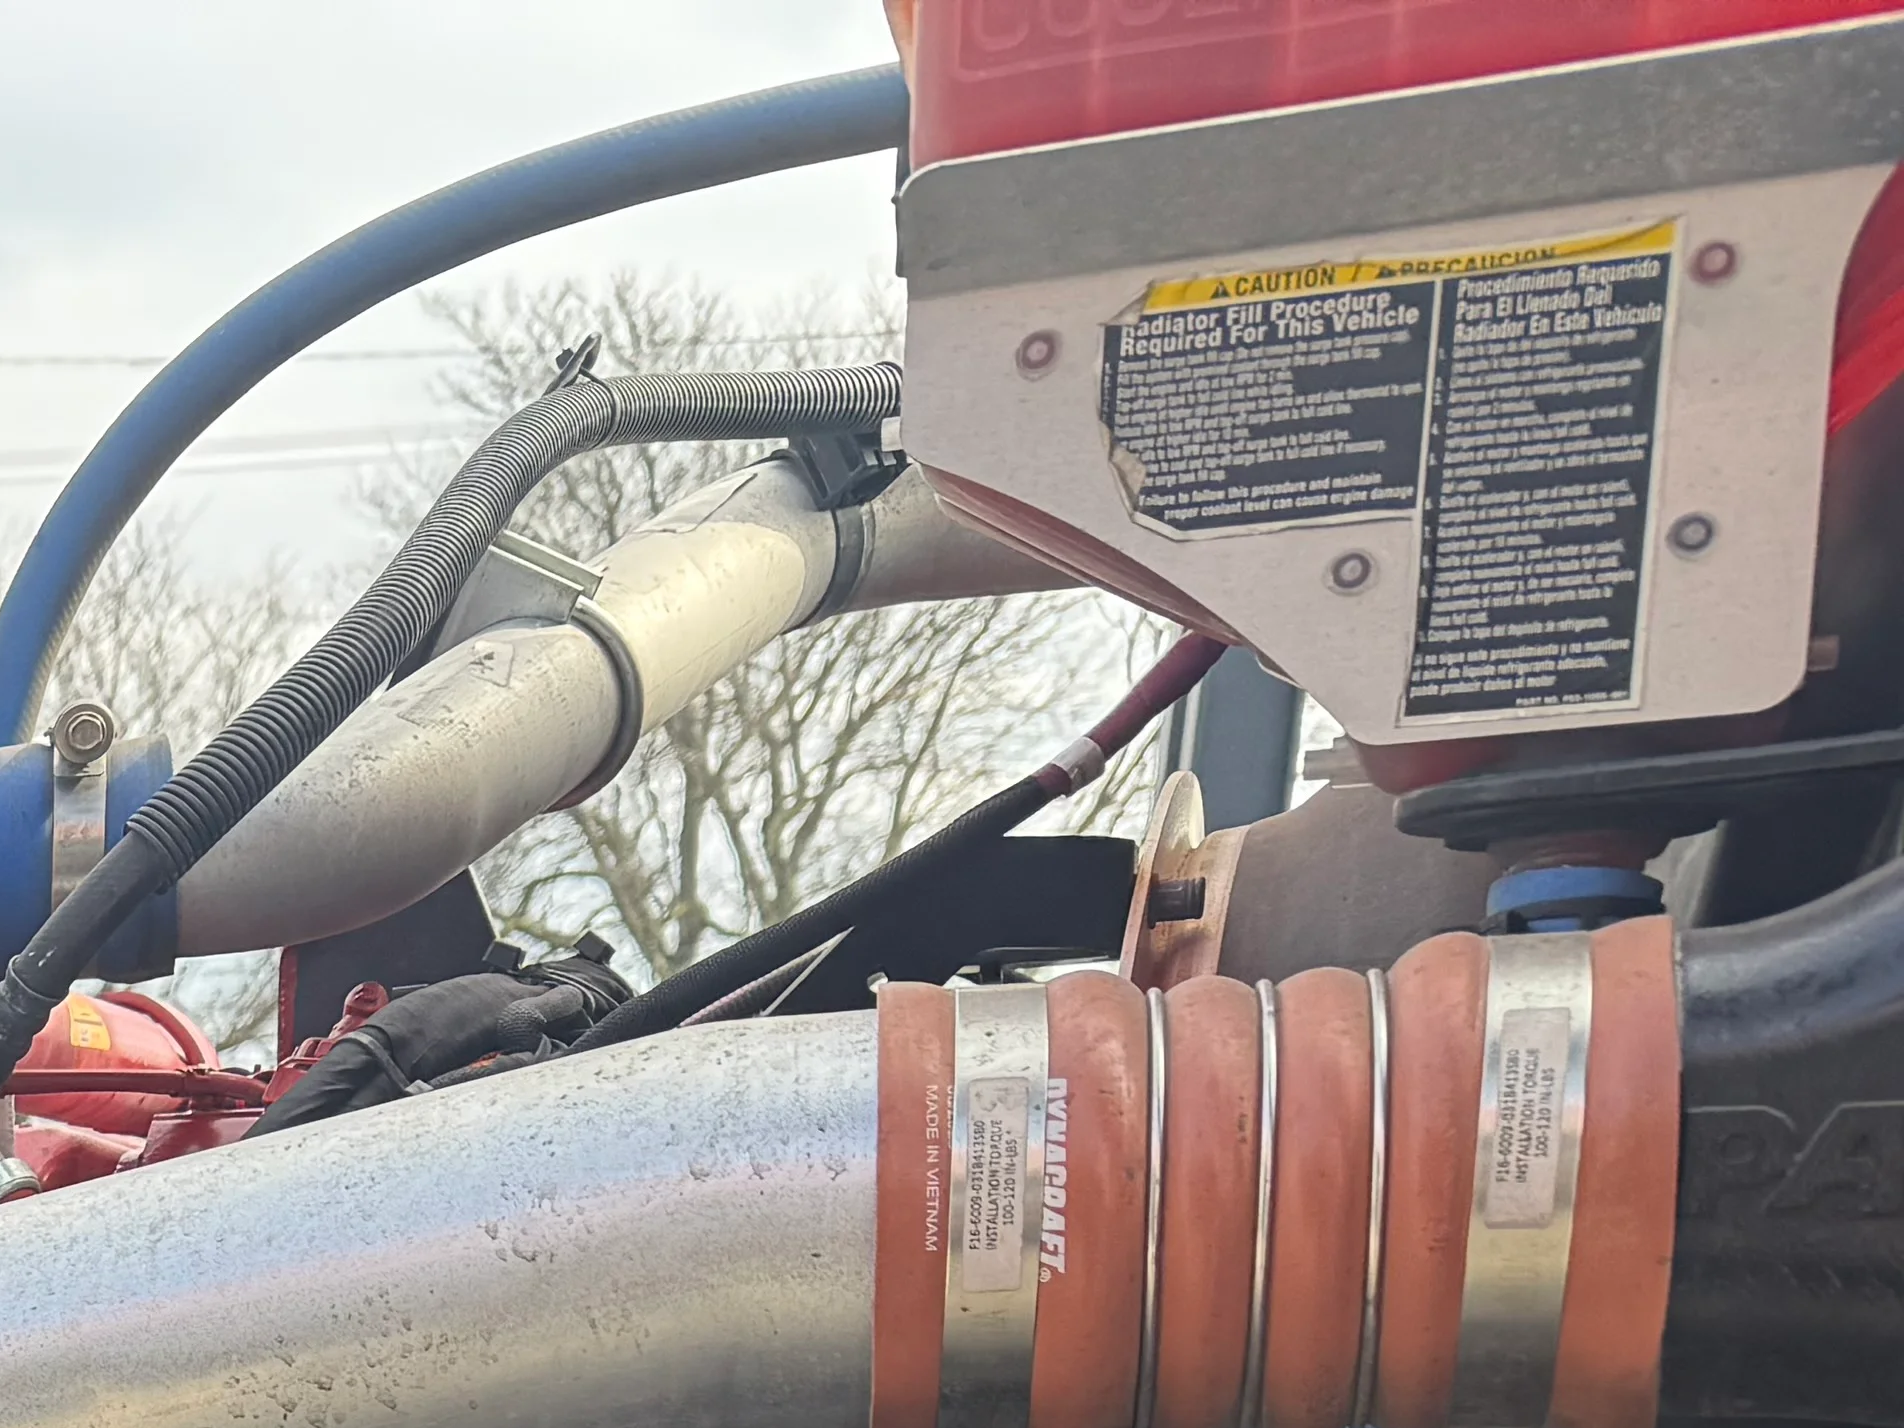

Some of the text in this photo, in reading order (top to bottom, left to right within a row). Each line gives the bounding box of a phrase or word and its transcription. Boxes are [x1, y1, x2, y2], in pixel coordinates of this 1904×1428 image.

[1226, 303, 1262, 327] Fill
[1270, 286, 1391, 321] Procedure
[1234, 265, 1335, 298] CAUTION
[1120, 327, 1222, 360] Required
[1230, 322, 1267, 345] For
[1274, 315, 1323, 339] This
[1333, 302, 1420, 332] Vehicle
[1514, 1047, 1540, 1184] INSTALLATION TORQUE
[924, 1085, 940, 1253] MADE IN VIETNAM
[985, 1119, 1003, 1251] INSTALLATION TORQUE
[1002, 1138, 1018, 1227] 100-120 IN-LBS
